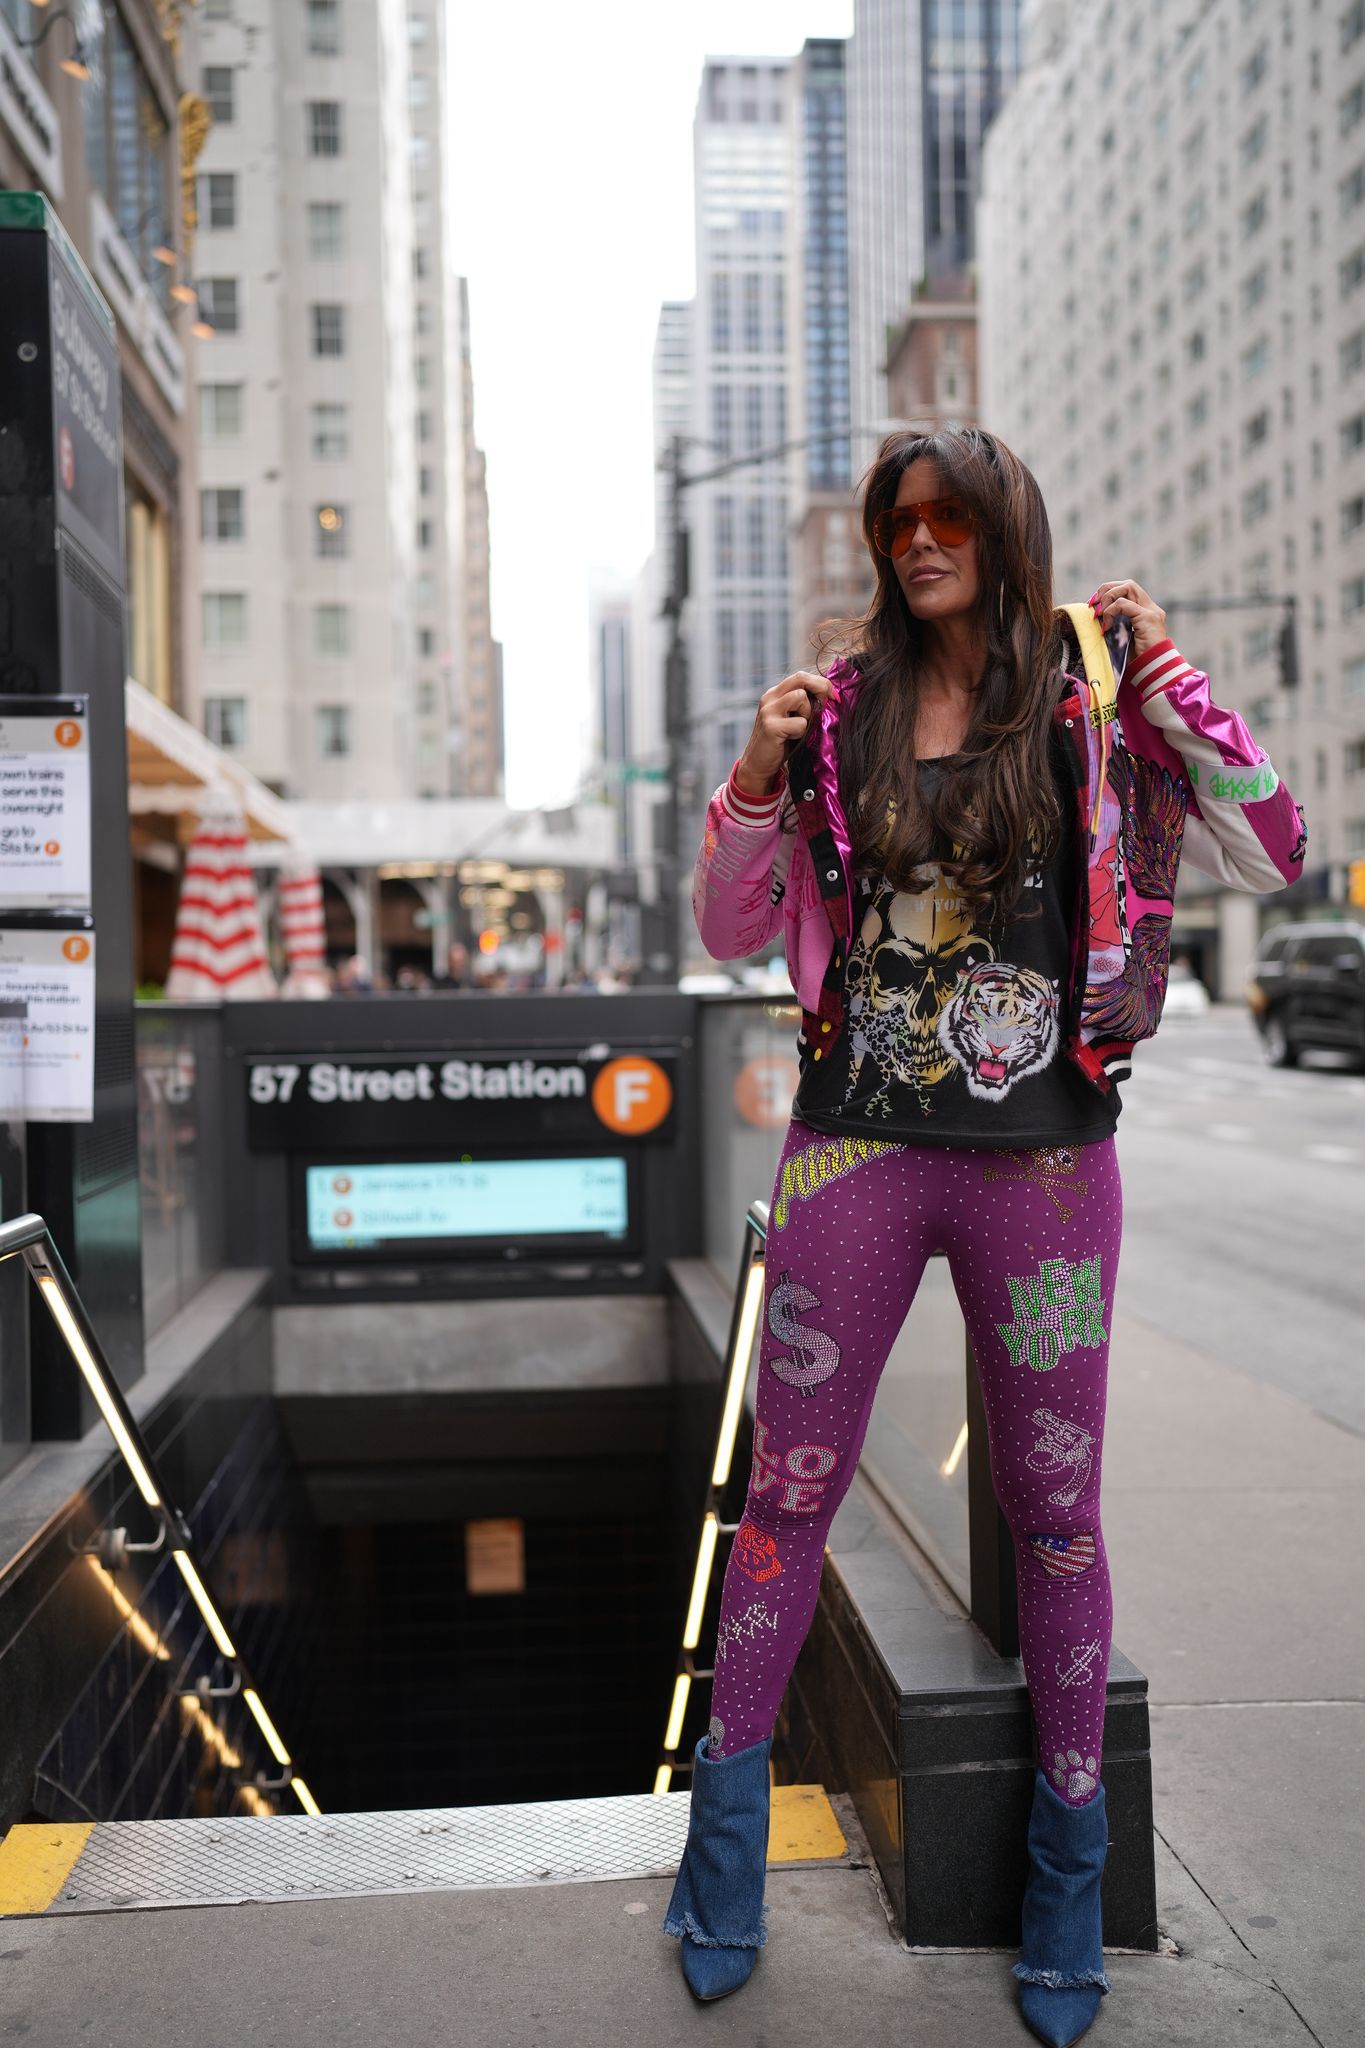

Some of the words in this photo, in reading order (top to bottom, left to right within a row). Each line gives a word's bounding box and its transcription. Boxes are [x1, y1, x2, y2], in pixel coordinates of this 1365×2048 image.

[249, 1064, 299, 1102] 57
[309, 1062, 434, 1102] Street
[441, 1058, 586, 1100] Station
[613, 1069, 652, 1122] F
[1005, 1254, 1102, 1322] NEW
[993, 1299, 1108, 1373] YORK
